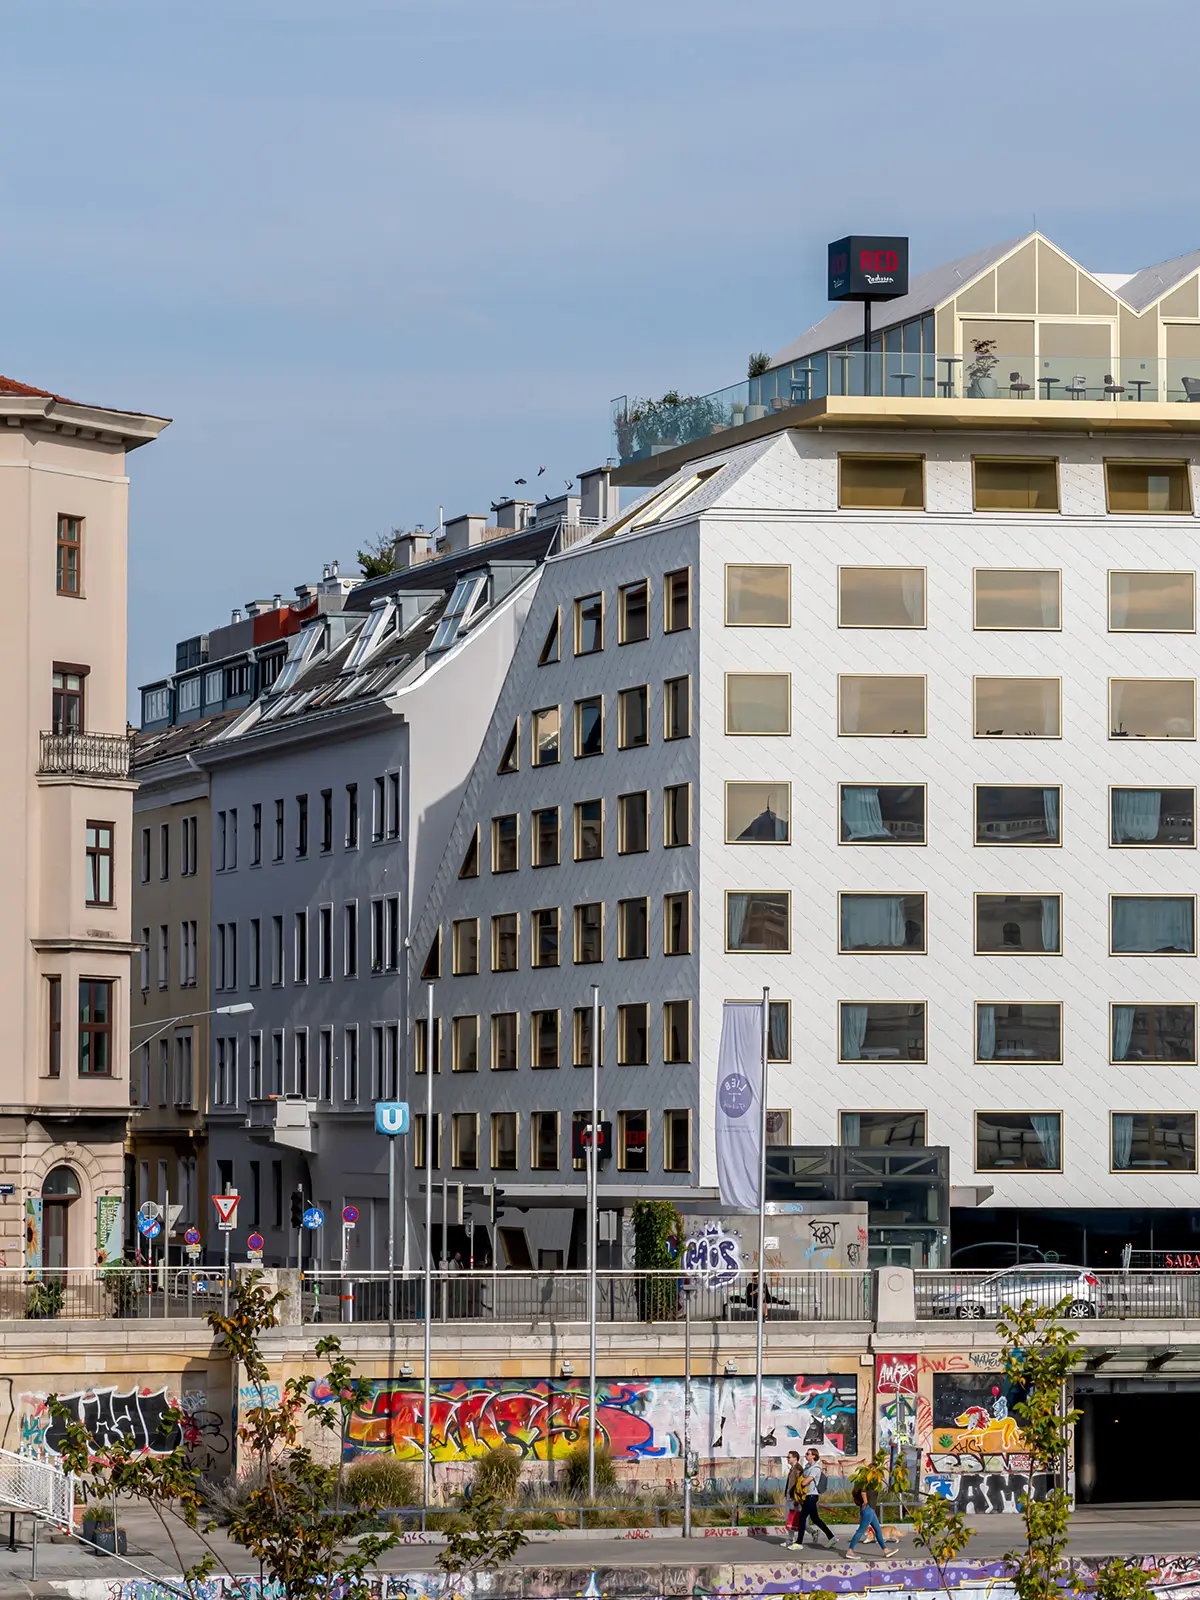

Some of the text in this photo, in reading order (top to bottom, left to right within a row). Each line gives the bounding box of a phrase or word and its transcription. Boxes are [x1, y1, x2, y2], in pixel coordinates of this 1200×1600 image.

[860, 250, 898, 272] RED
[864, 274, 894, 284] Radisson
[382, 1109, 403, 1131] U
[917, 1356, 970, 1374] AWS
